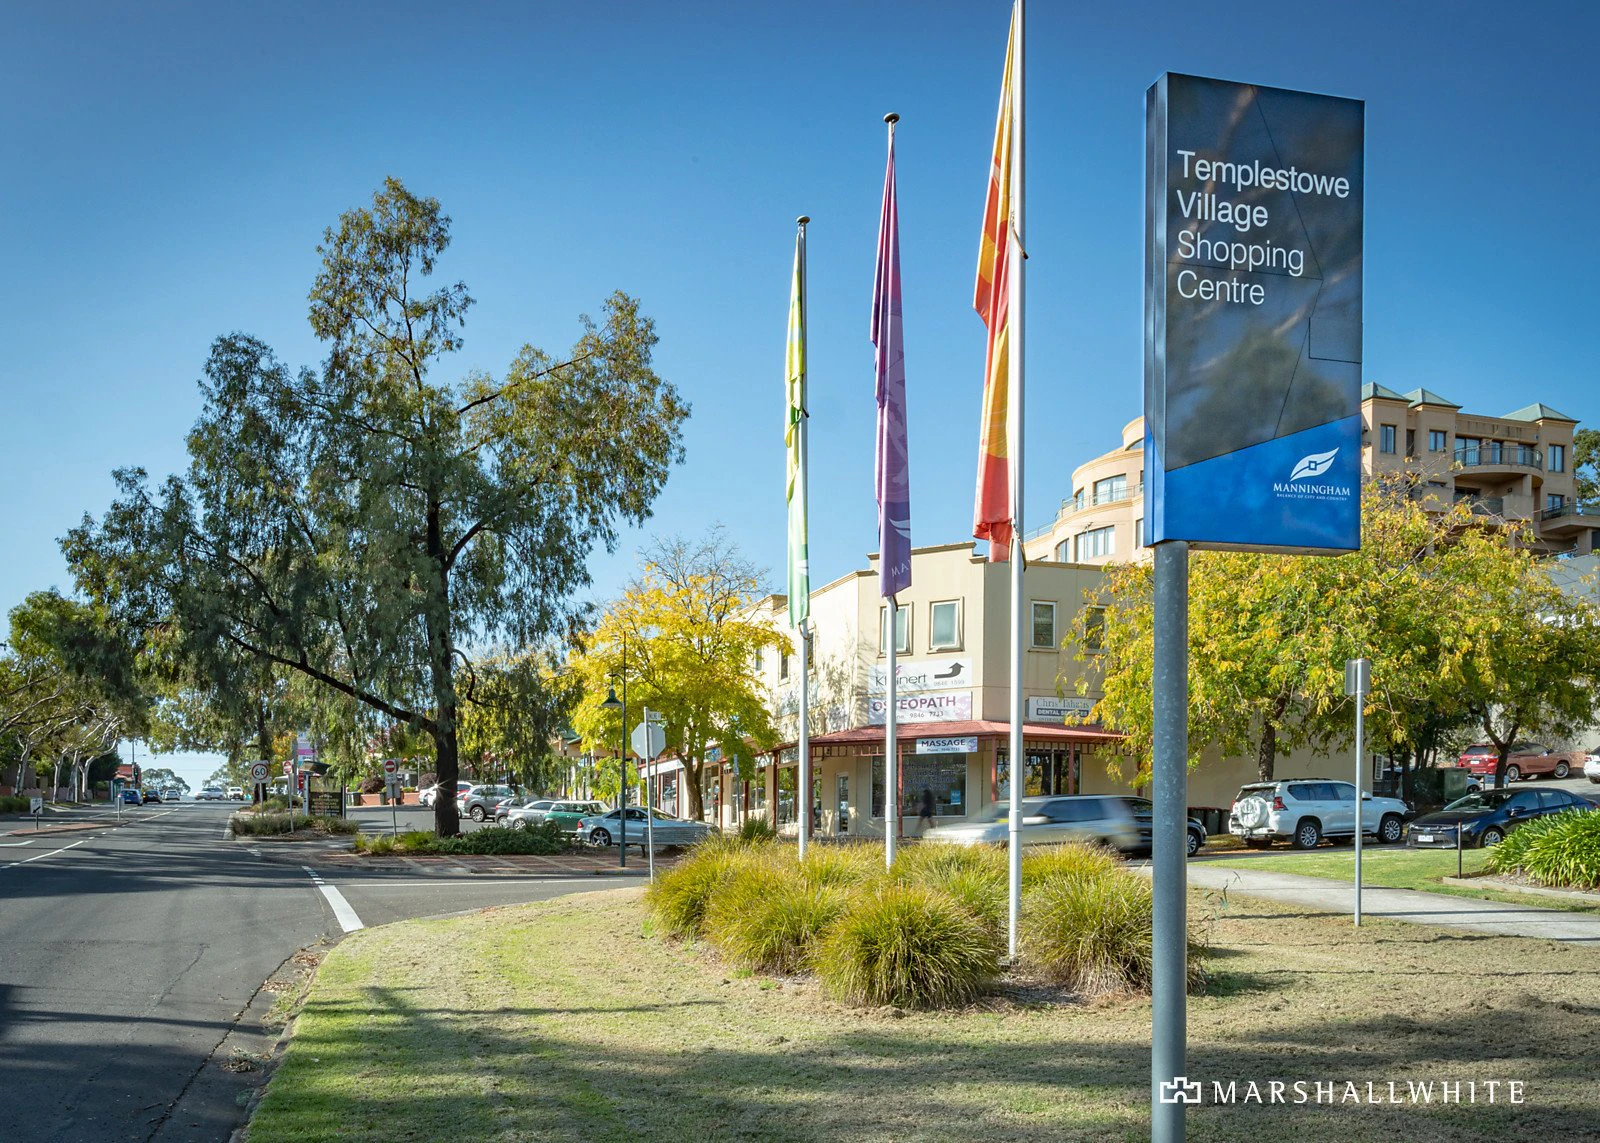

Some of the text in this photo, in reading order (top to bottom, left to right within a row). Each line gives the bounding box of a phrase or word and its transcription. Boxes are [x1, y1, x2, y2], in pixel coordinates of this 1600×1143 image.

[1176, 149, 1350, 199] Templestowe
[1176, 189, 1269, 232] Village
[1177, 230, 1304, 277] Shopping
[1177, 270, 1265, 305] Centre
[1273, 482, 1351, 496] MANNINGHAM
[891, 559, 911, 577] MA
[875, 673, 927, 688] Klinert
[921, 738, 966, 747] MASSAGE
[255, 767, 266, 776] 60
